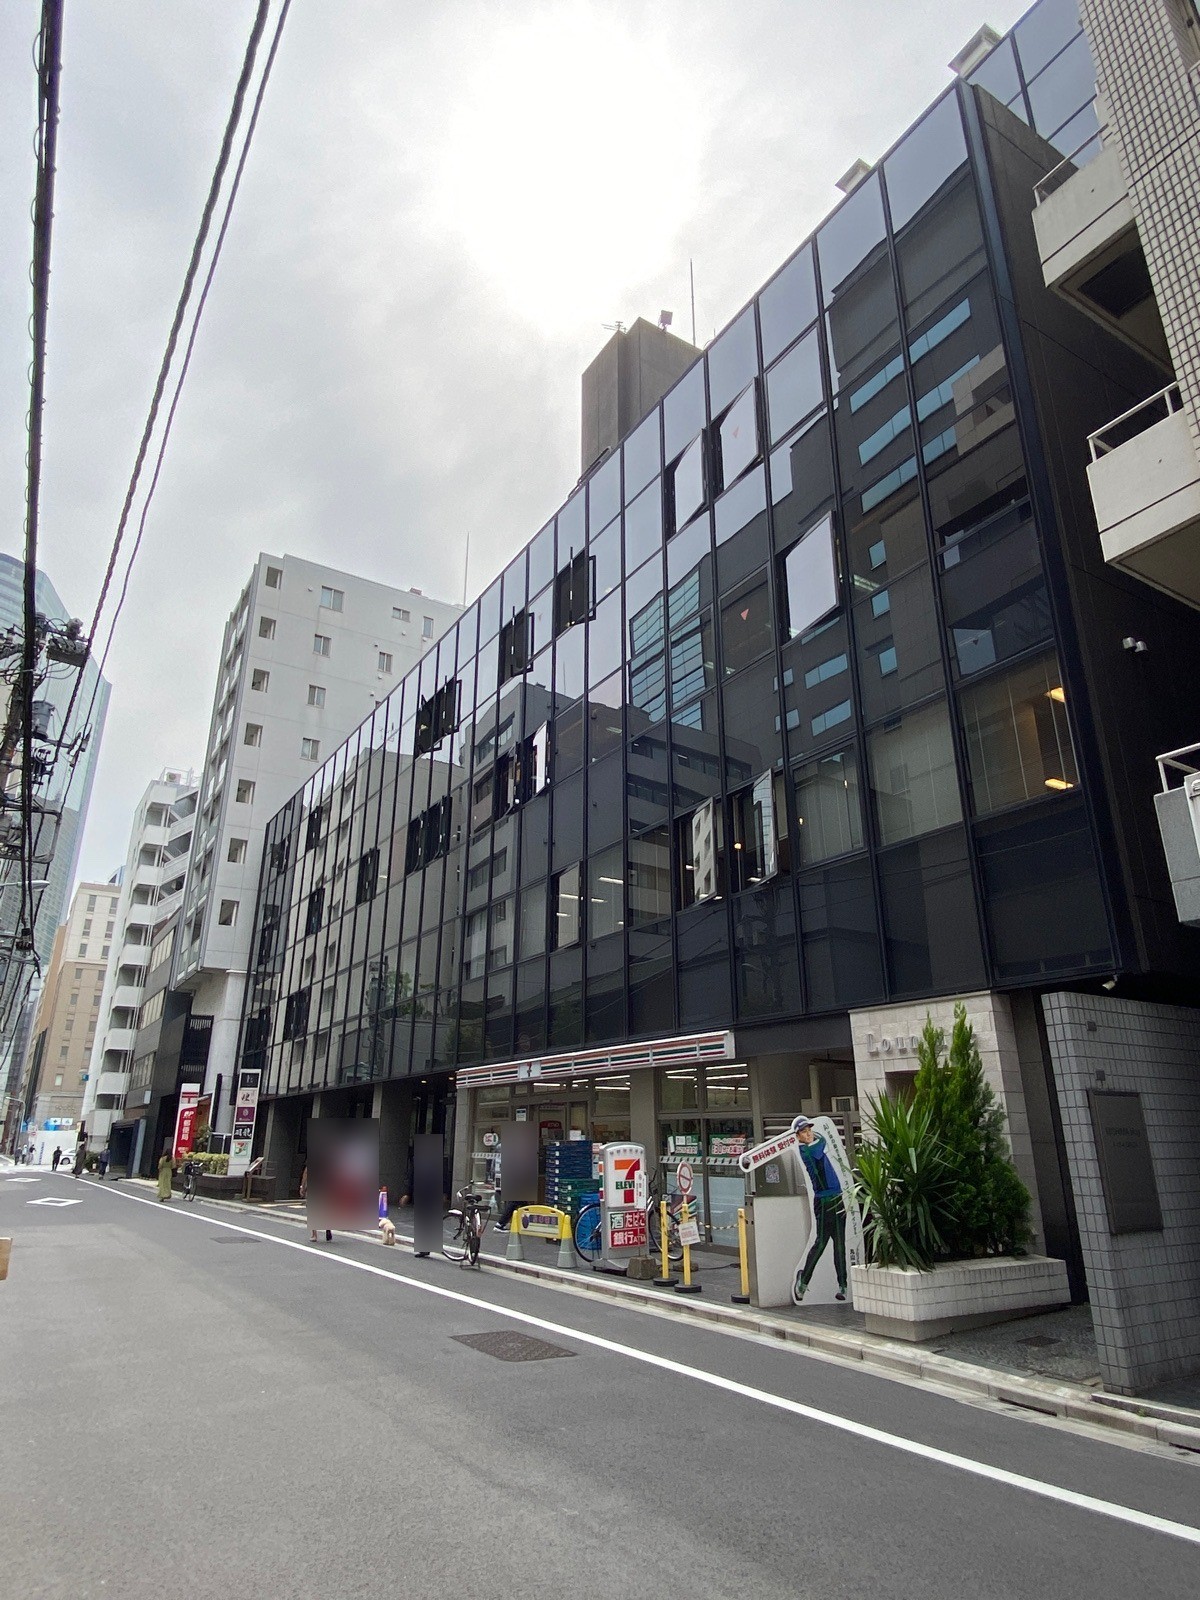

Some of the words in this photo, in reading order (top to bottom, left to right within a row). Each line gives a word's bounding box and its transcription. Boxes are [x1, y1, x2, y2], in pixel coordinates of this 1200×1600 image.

[615, 1181, 635, 1190] ELEV
[611, 1214, 624, 1230] 酒
[625, 1212, 646, 1228] たばこ
